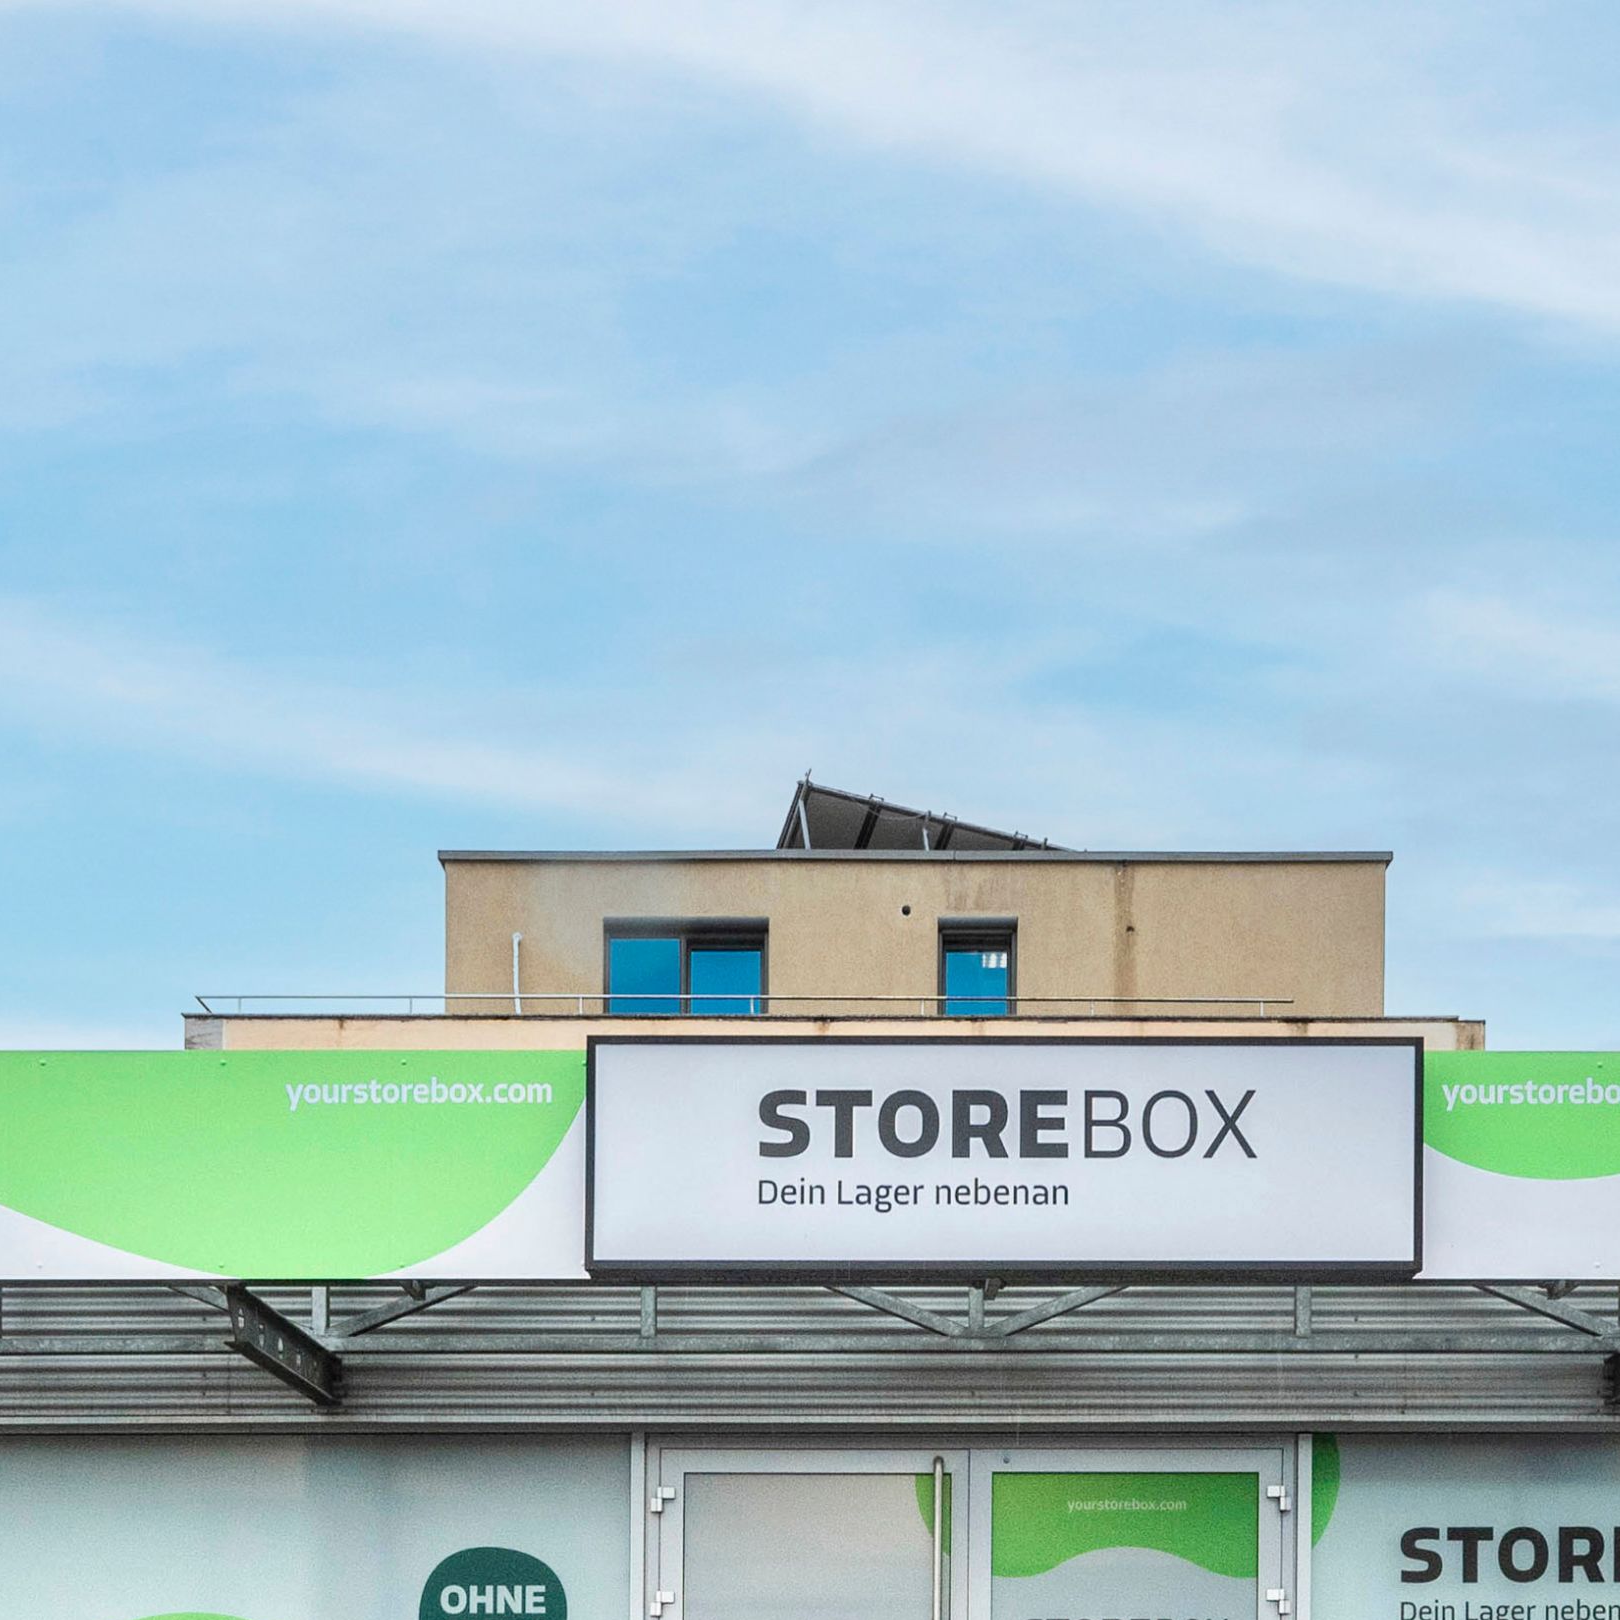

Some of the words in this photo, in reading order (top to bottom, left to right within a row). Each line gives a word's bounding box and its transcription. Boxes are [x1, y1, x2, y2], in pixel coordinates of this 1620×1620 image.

[285, 1076, 553, 1112] yourstorebox.com
[758, 1089, 1258, 1159] STOREBOX
[757, 1178, 825, 1205] Dein
[837, 1179, 924, 1213] Lager
[935, 1178, 1070, 1205] nebenan
[1067, 1498, 1187, 1513] yourstorebox.com
[440, 1584, 546, 1614] OHNE
